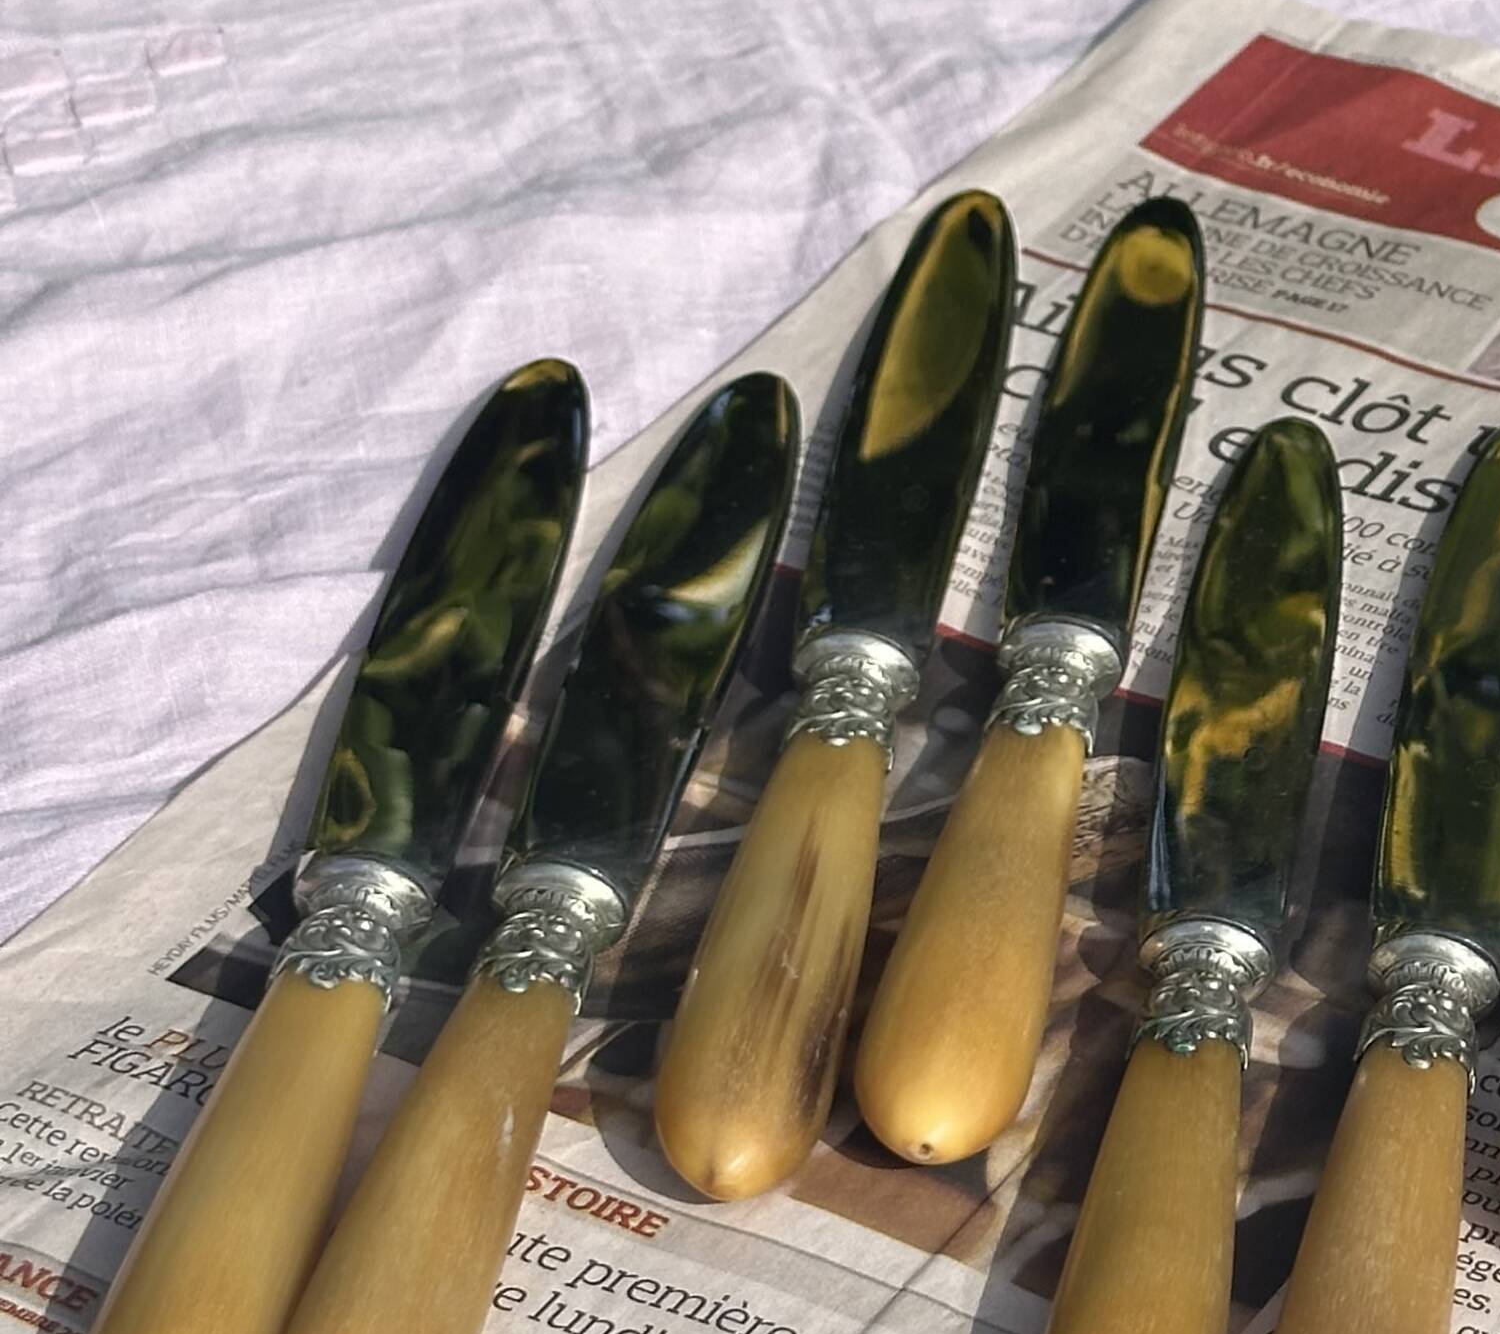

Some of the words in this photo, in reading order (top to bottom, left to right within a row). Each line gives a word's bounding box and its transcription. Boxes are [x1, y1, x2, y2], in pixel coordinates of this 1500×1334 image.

[1280, 376, 1453, 446] clôt
[98, 1015, 146, 1043] le
[42, 1174, 71, 1203] la
[524, 1166, 670, 1239] STOIRE
